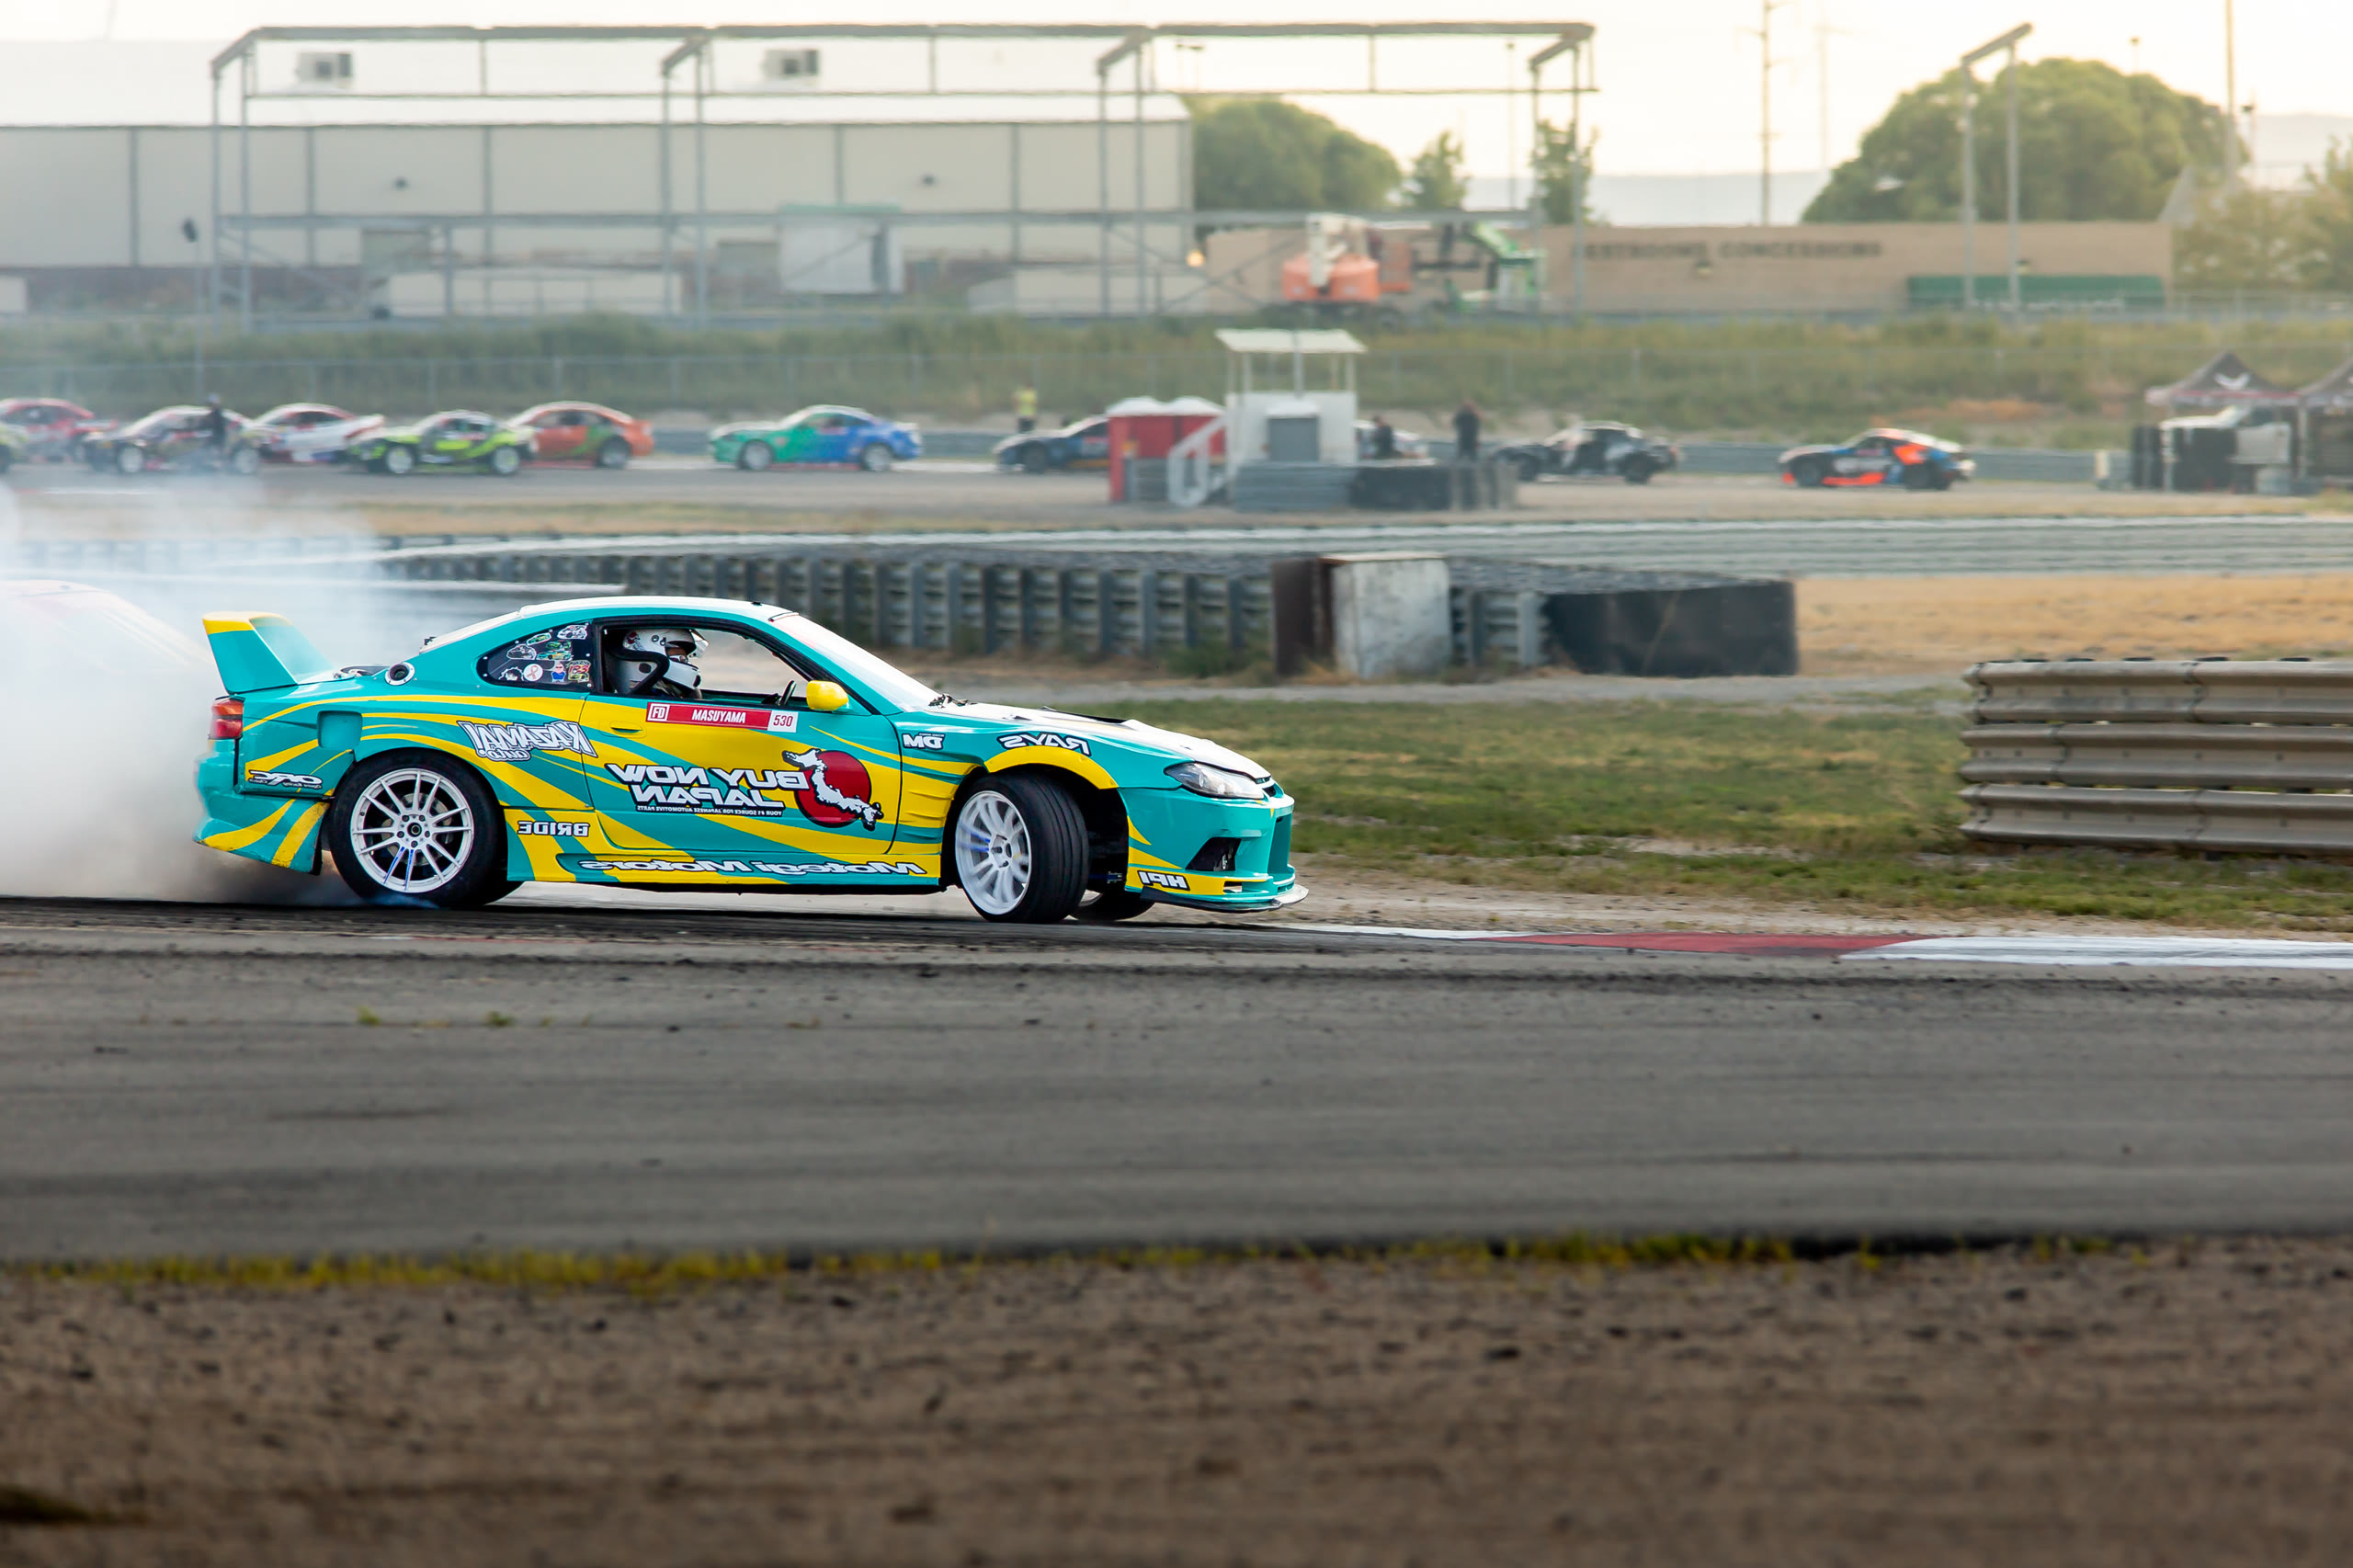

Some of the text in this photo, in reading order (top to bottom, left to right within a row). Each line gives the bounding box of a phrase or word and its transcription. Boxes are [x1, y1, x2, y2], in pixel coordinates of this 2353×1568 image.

[652, 705, 793, 727] FD MASUYAMA 530
